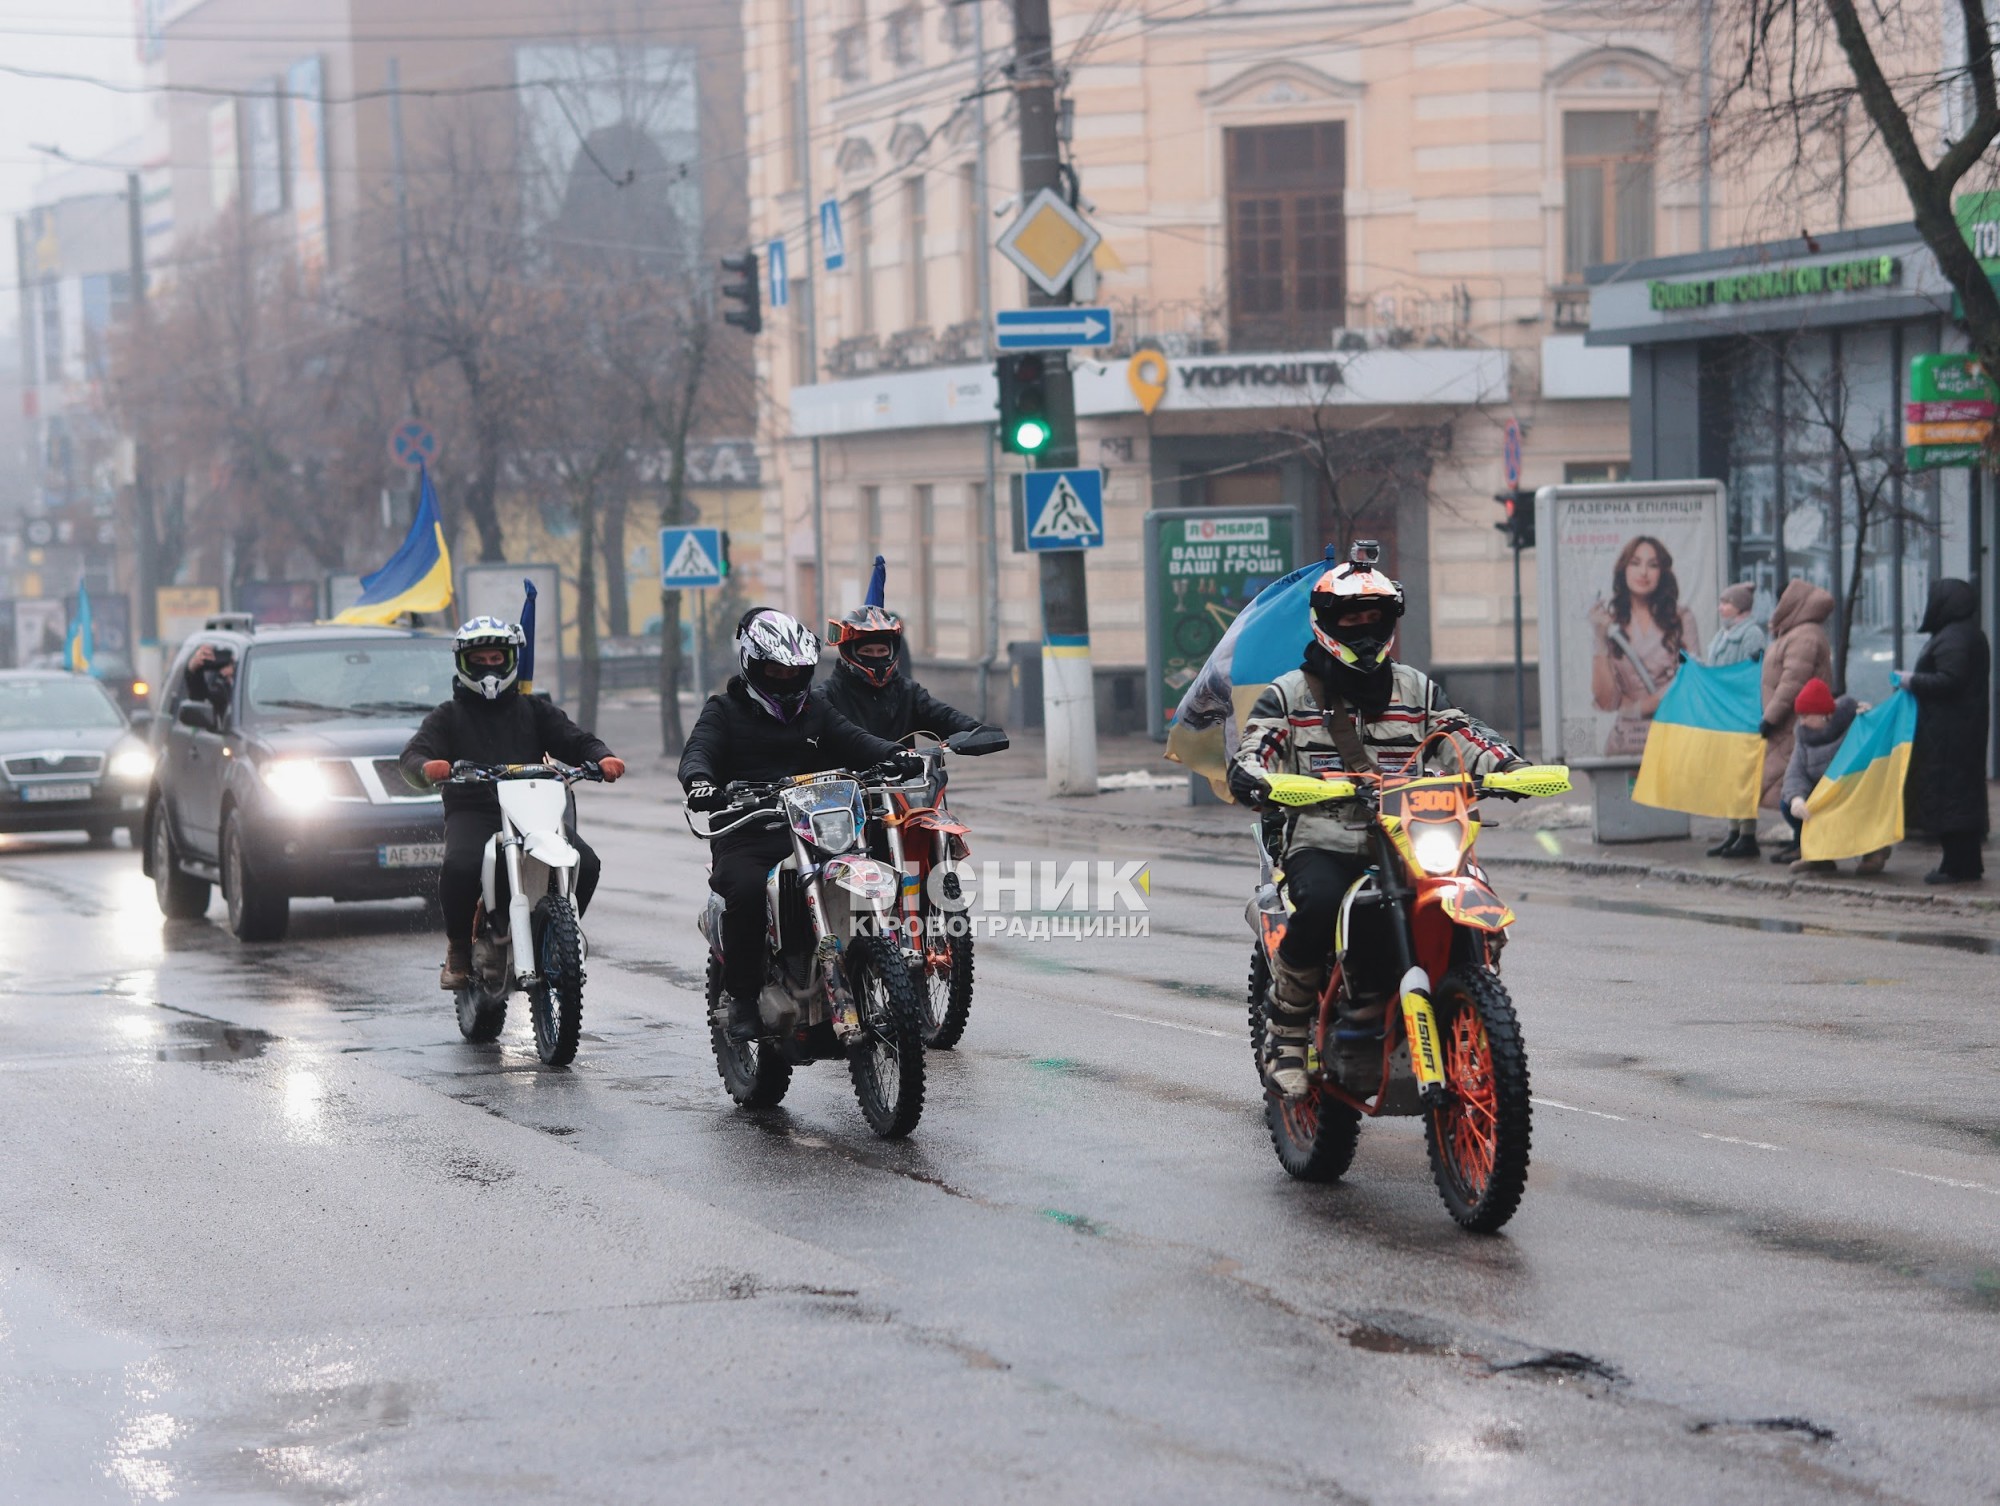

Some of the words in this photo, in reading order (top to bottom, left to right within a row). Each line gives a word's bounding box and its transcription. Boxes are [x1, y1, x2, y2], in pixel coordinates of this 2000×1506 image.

[1971, 221, 2000, 259] TO
[1714, 266, 1822, 304] INFORMATION
[1827, 255, 1893, 287] CENTER
[1178, 361, 1345, 388] УКРПОШТА
[1567, 502, 1632, 514] ЛАЗЕРНА
[1637, 500, 1703, 514] ЕПІЛЯЦІЯ
[1189, 521, 1265, 539] ЛОМБАРД
[1172, 546, 1220, 560] ВАШІ
[1169, 561, 1217, 575] ВАШІ
[1223, 559, 1283, 573] ГРОШІ
[688, 786, 717, 798] FOX
[1409, 790, 1456, 812] 300
[388, 848, 408, 862] AE
[1418, 1023, 1437, 1073] SHIFT
